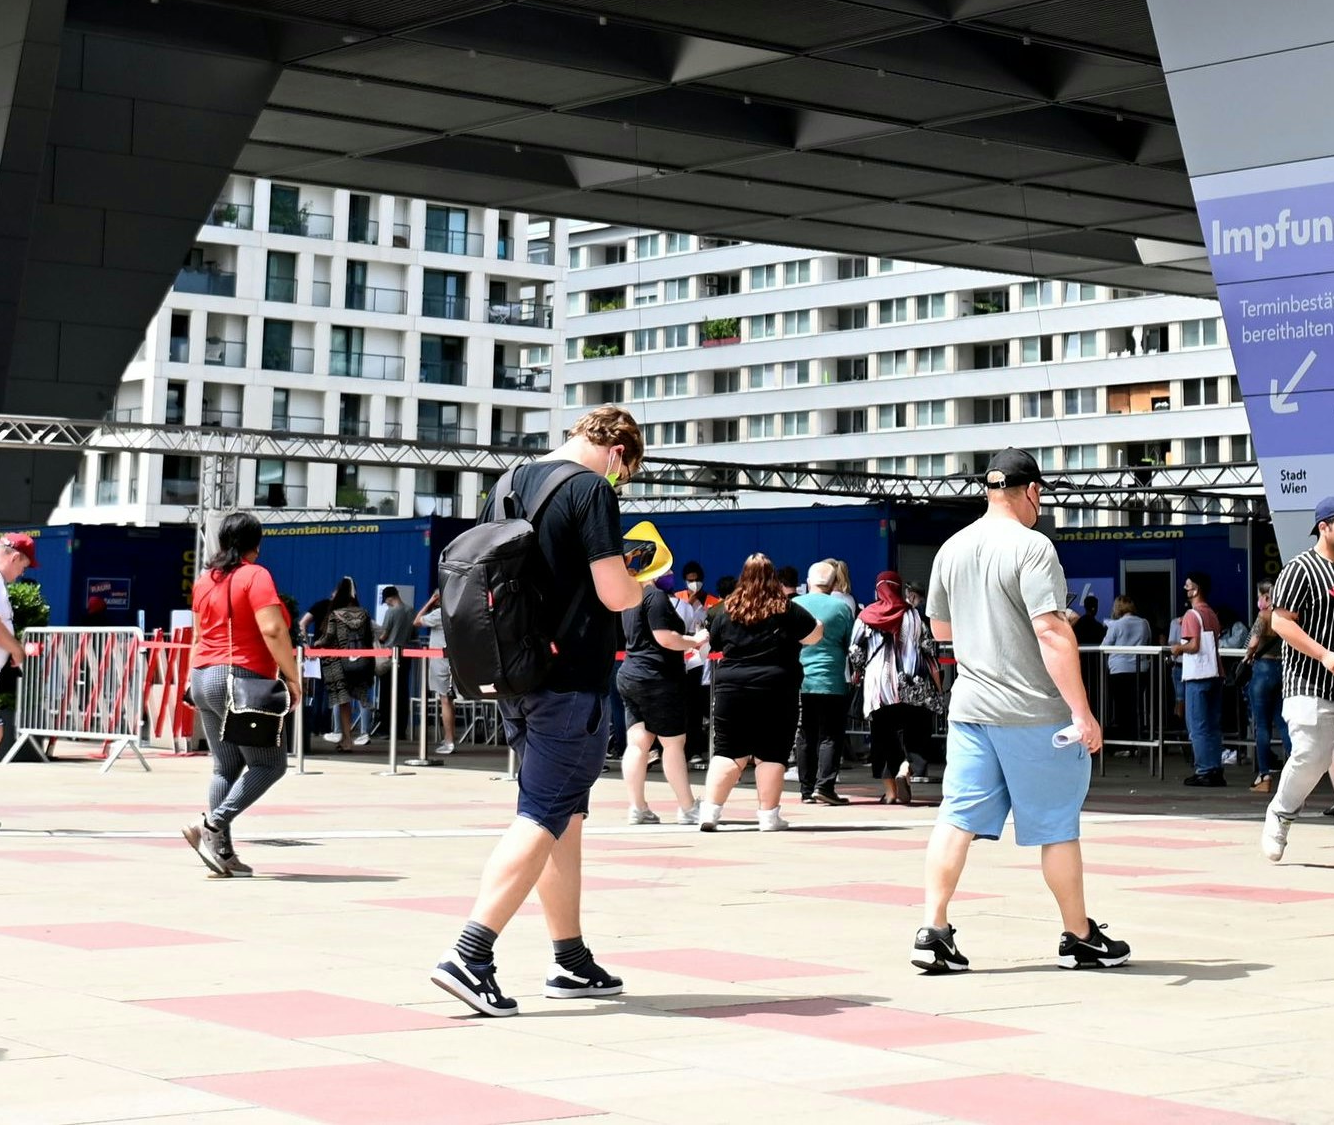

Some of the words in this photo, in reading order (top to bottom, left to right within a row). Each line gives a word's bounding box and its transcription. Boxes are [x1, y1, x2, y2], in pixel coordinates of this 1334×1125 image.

[1242, 319, 1334, 344] bereithalten
[1280, 469, 1307, 482] Stadt
[1280, 483, 1308, 494] Wien
